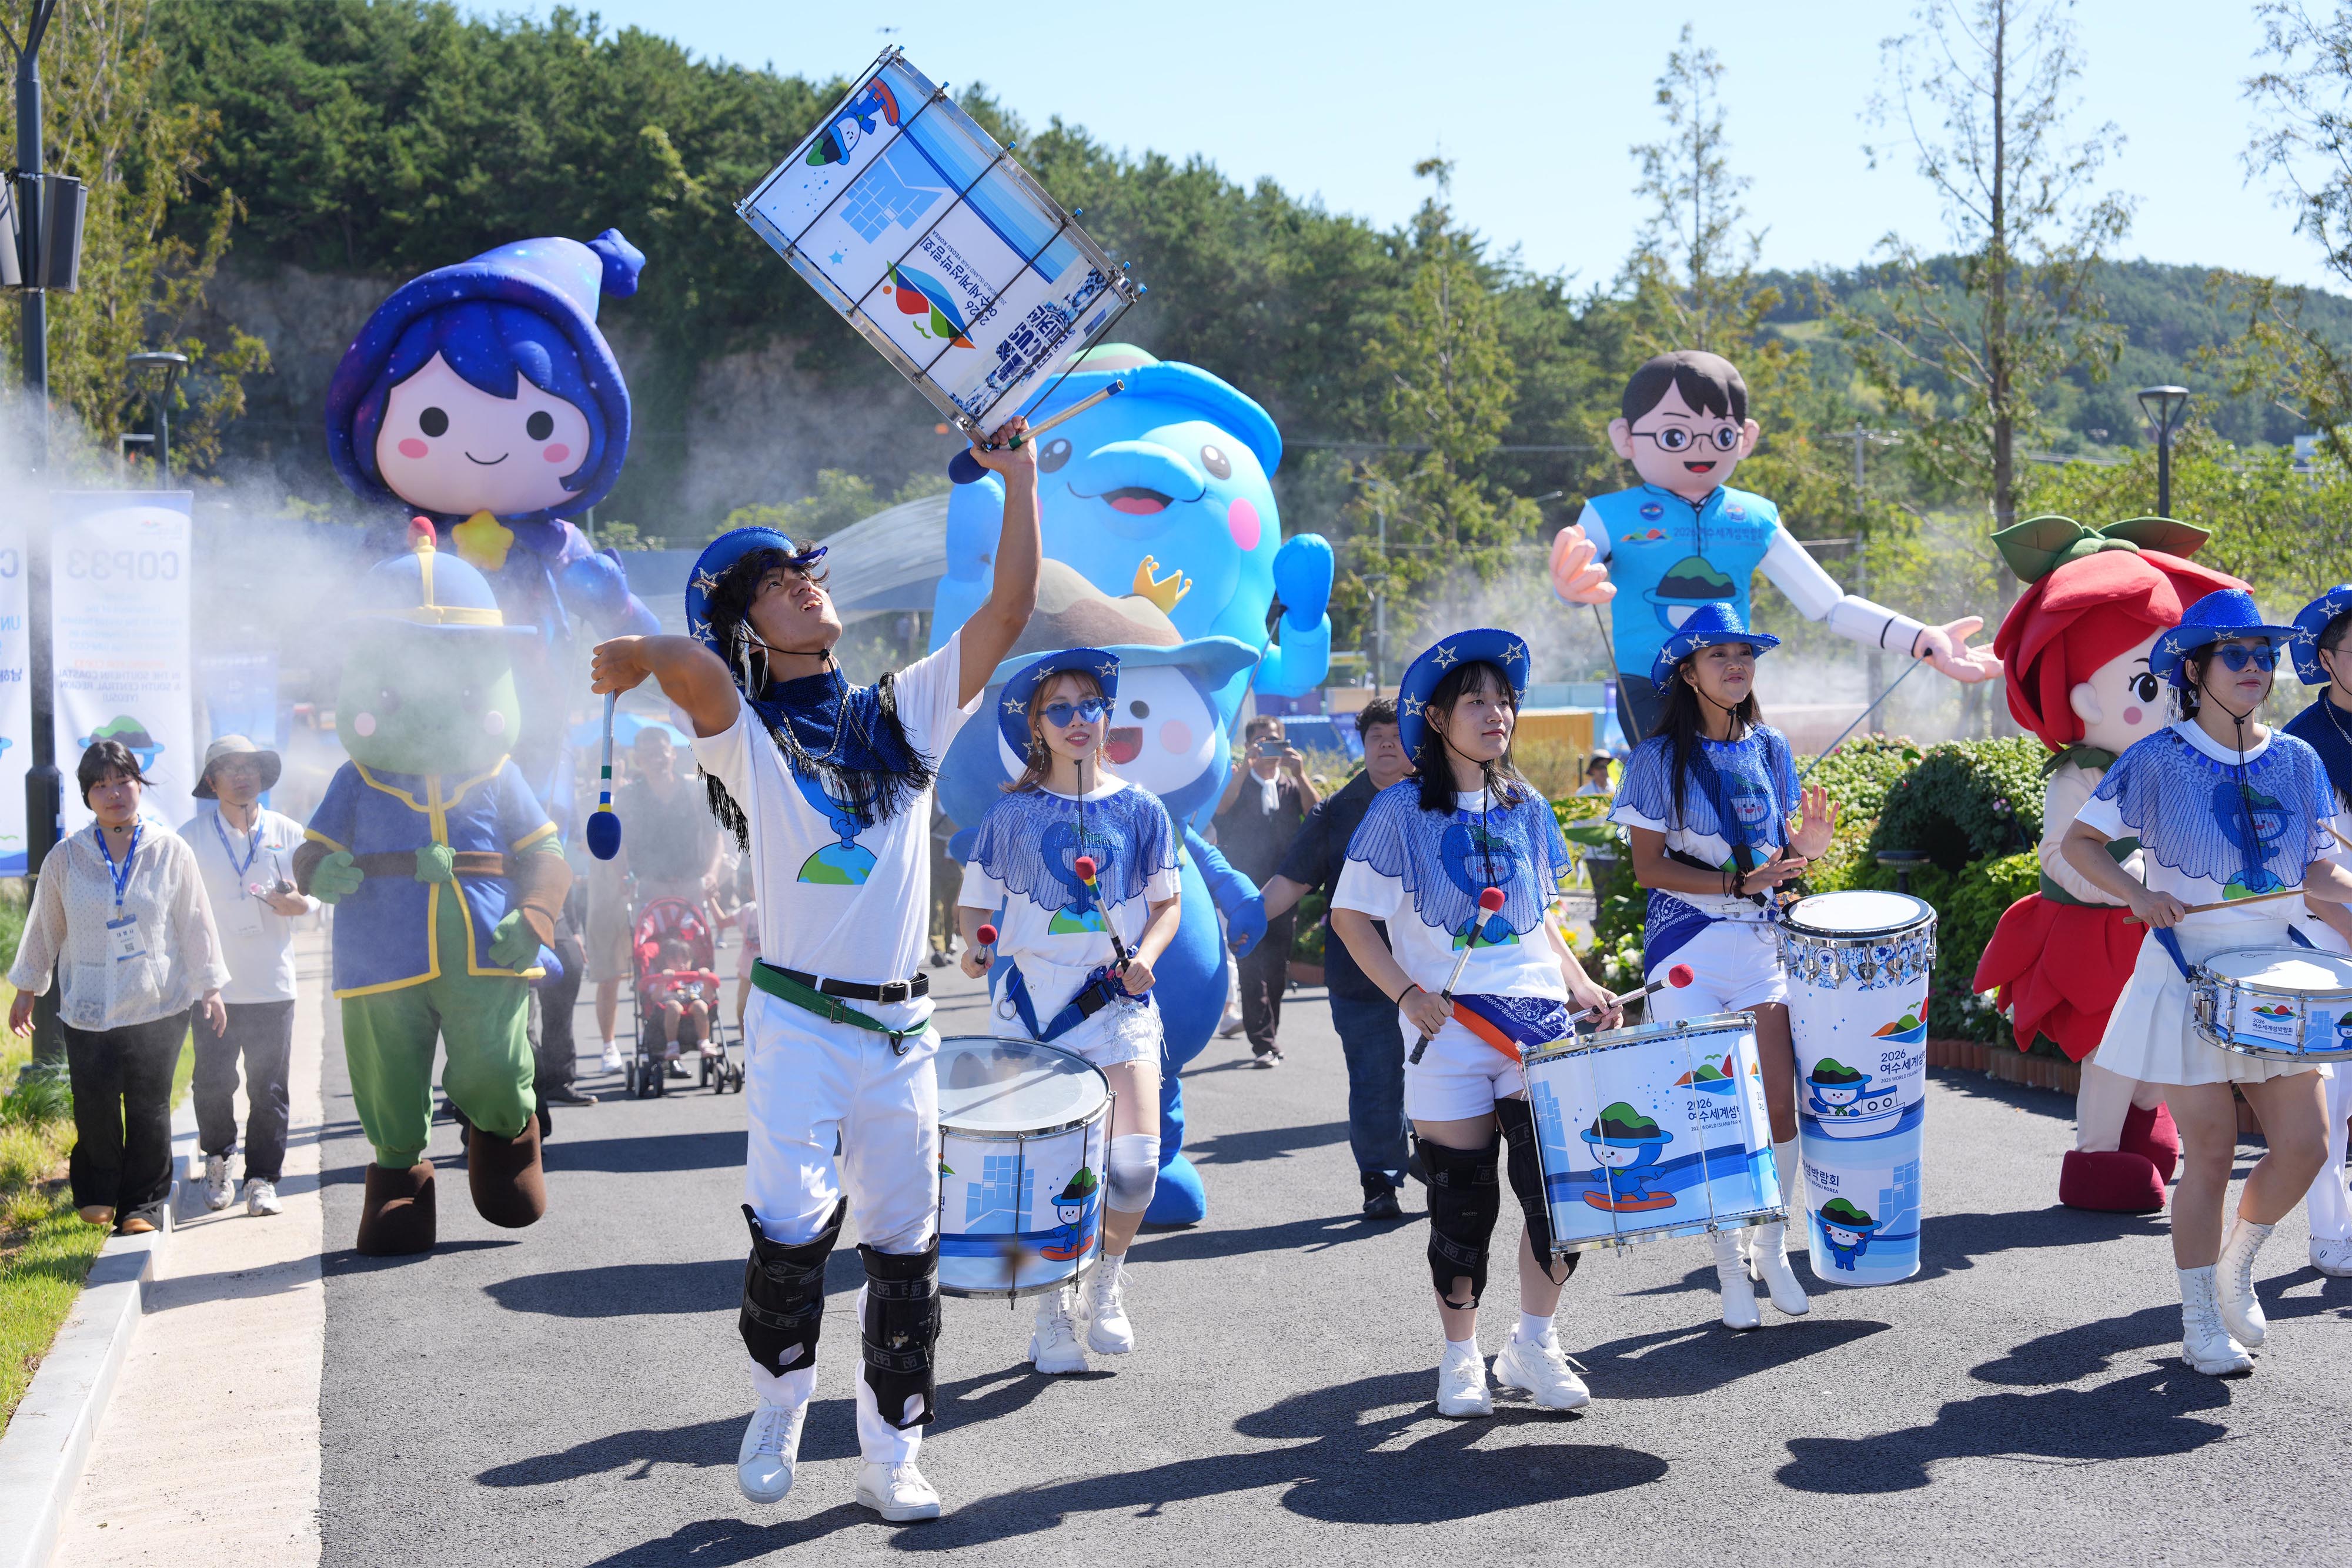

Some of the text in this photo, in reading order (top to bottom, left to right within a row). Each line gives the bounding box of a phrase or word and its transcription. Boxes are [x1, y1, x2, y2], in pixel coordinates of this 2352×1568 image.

[932, 230, 947, 246] KOREA
[946, 245, 962, 260] YEOSU
[961, 259, 971, 269] FAIR
[919, 236, 997, 316] 여수세계섬박람회
[970, 268, 985, 283] ISLAND
[984, 282, 999, 297] WORLD
[965, 300, 990, 326] 2026
[2253, 1023, 2293, 1033] 여수세계섬박람회
[1881, 1048, 1906, 1062] 2026
[1907, 1069, 1918, 1078] ISLAND
[1687, 1098, 1712, 1111] 2026
[1811, 1179, 1839, 1194] YEOSU KOREA
